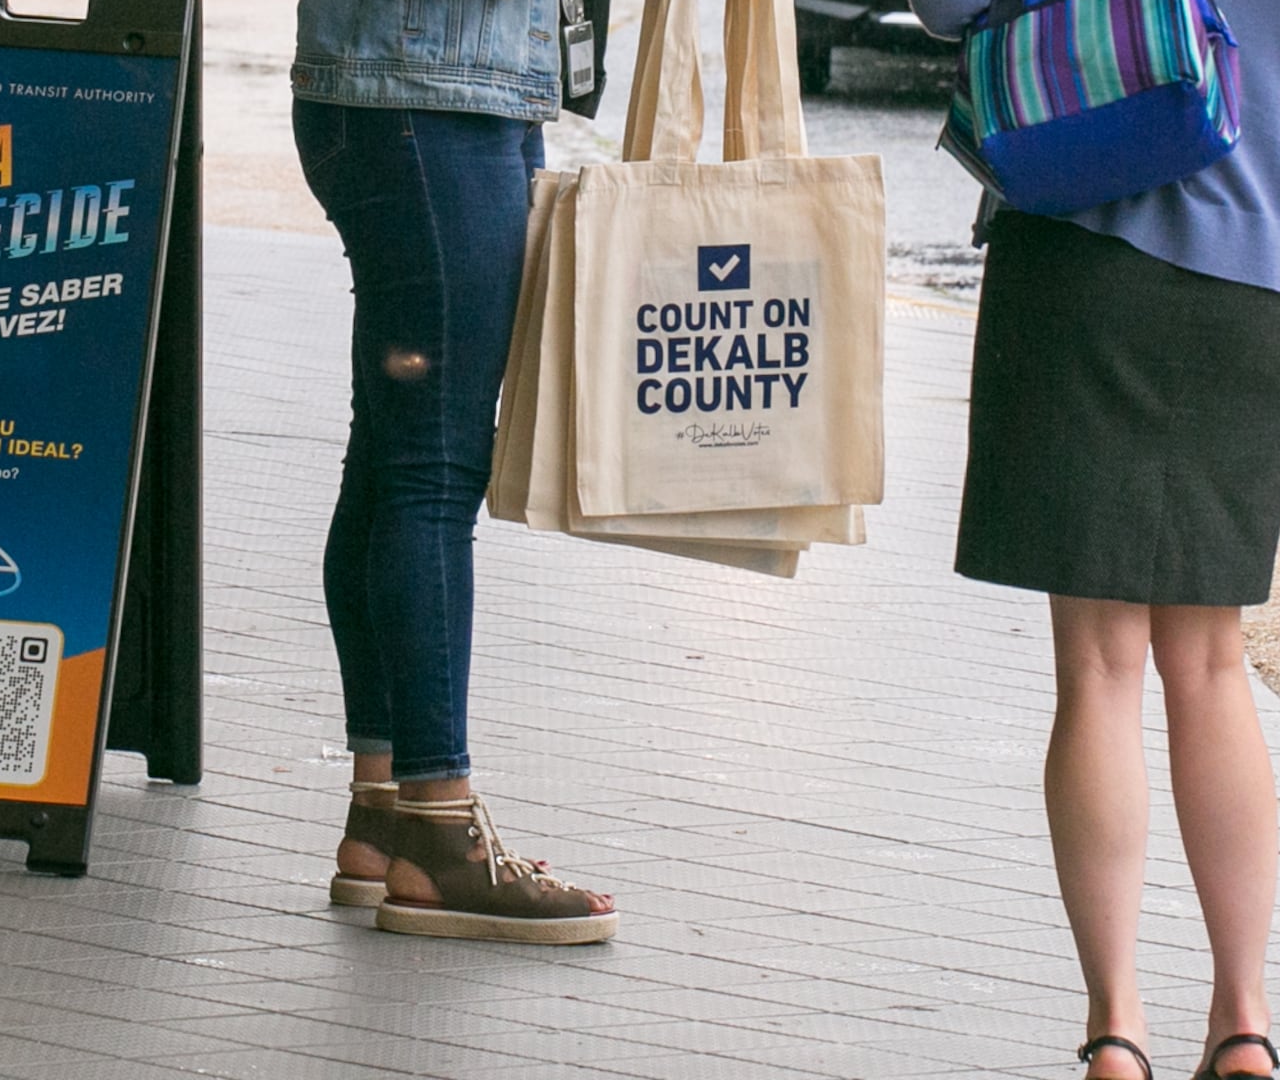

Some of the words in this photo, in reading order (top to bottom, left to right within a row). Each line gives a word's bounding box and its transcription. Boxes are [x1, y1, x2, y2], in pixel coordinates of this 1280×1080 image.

[9, 83, 68, 98] TRANSIT
[74, 88, 155, 104] AUTHORITY
[20, 273, 124, 307] SABER
[636, 299, 754, 334] COUNT
[763, 297, 810, 328] ON
[636, 332, 810, 374] DEKALB
[636, 373, 809, 415] COUNTY
[8, 440, 84, 459] IDEAL?
